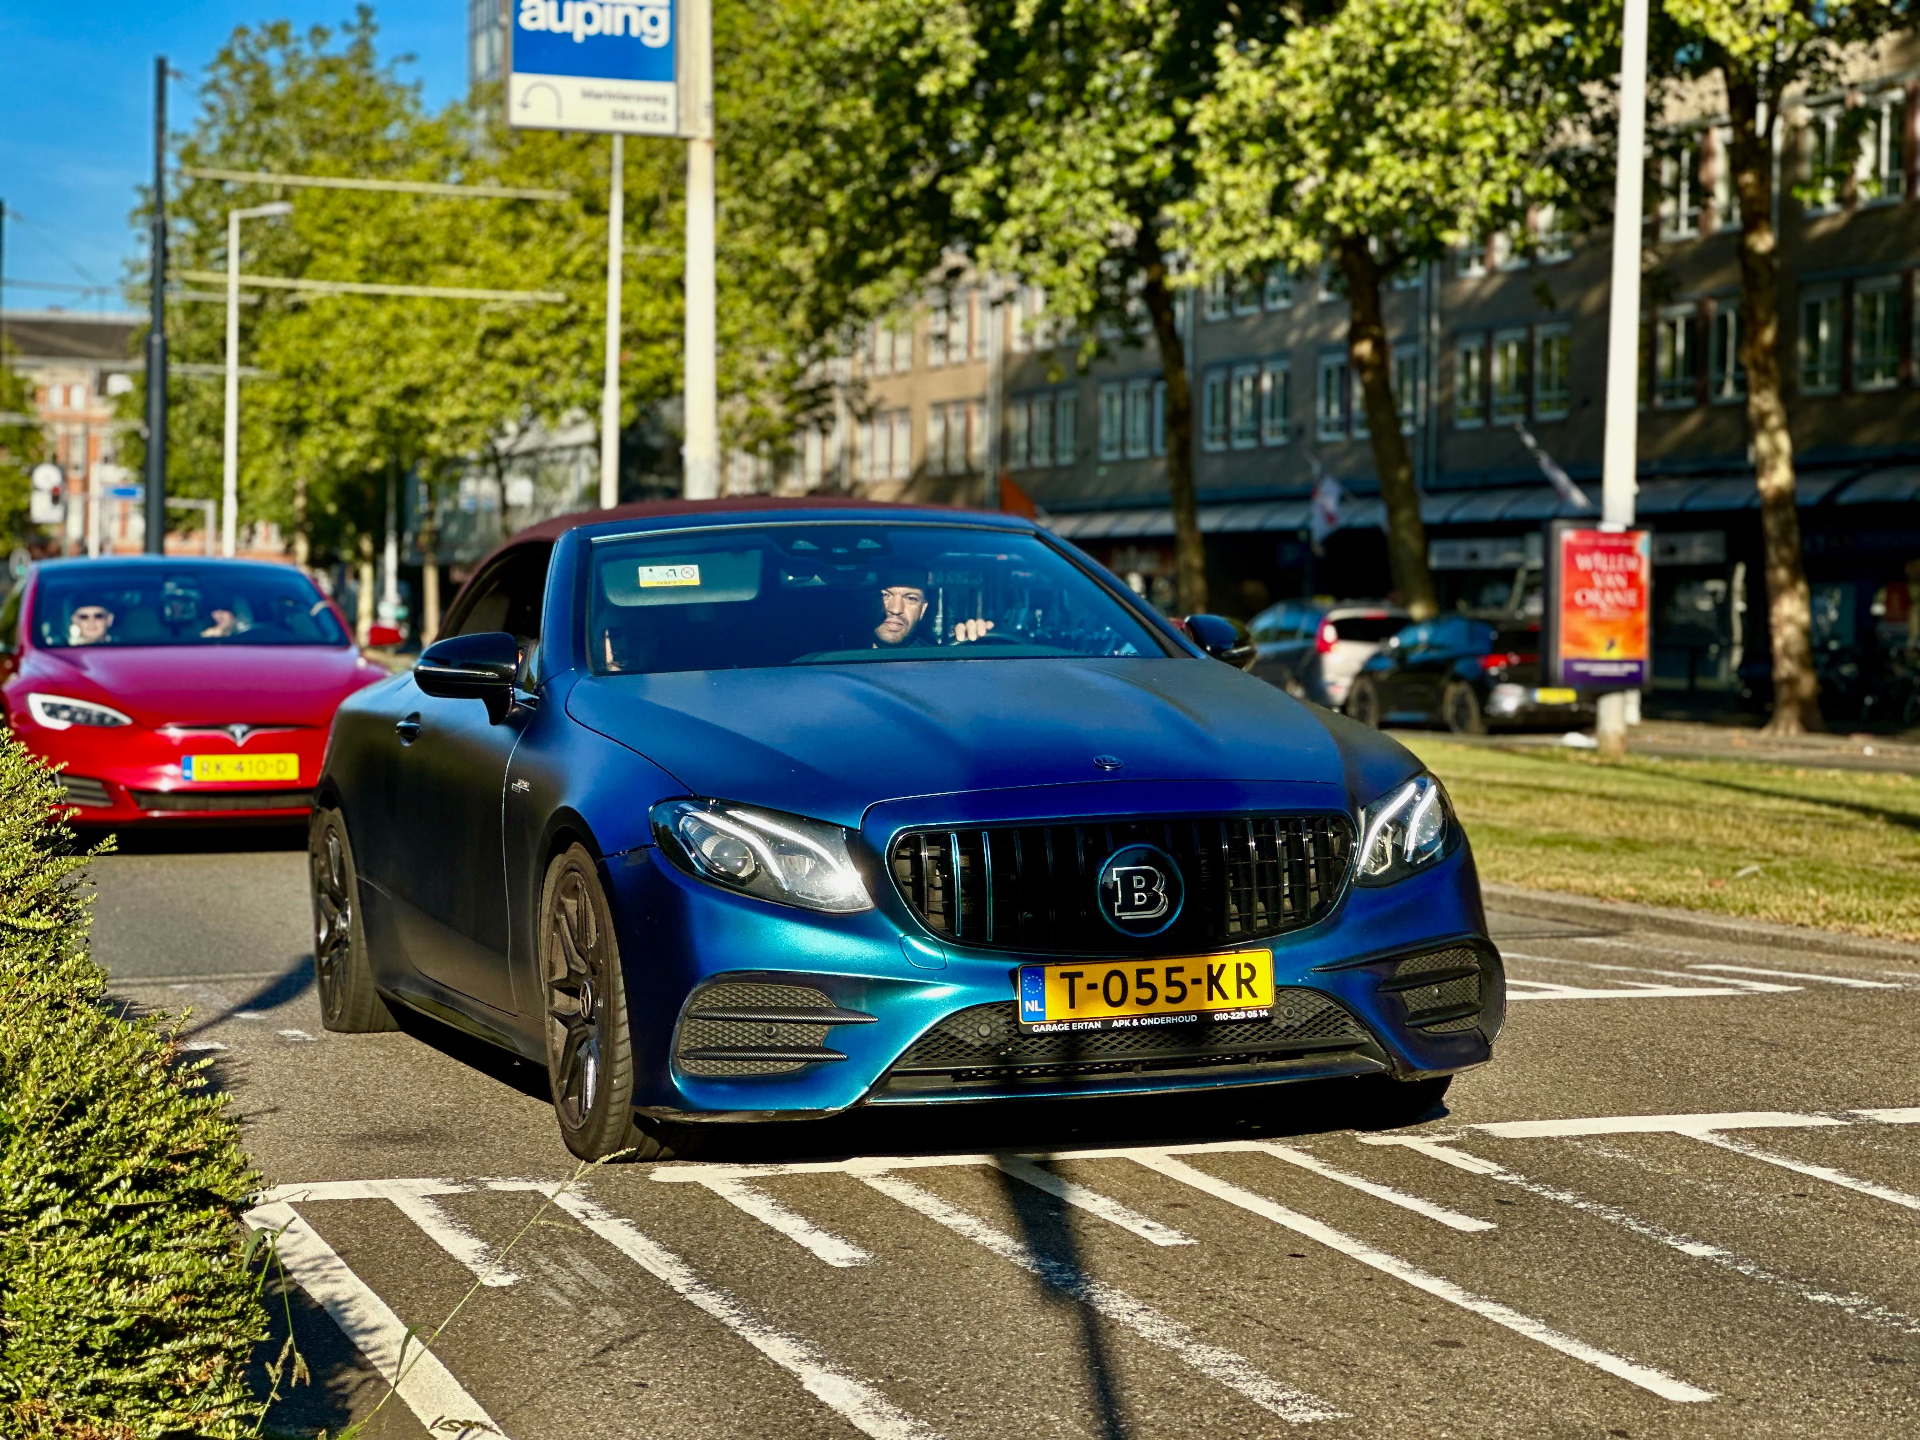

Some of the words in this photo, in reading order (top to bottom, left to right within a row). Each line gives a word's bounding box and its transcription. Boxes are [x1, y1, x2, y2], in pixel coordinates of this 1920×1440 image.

[518, 0, 671, 48] auping
[1060, 962, 1258, 1010] T-055-KR
[1025, 1000, 1043, 1012] NL
[1032, 1022, 1070, 1033] GARAGE
[1072, 1020, 1102, 1030] ERTAN
[1112, 1018, 1131, 1027] APK
[1132, 1018, 1139, 1026] &
[1140, 1014, 1198, 1026] ONDERHOUD
[1213, 1011, 1246, 1021] 010-229
